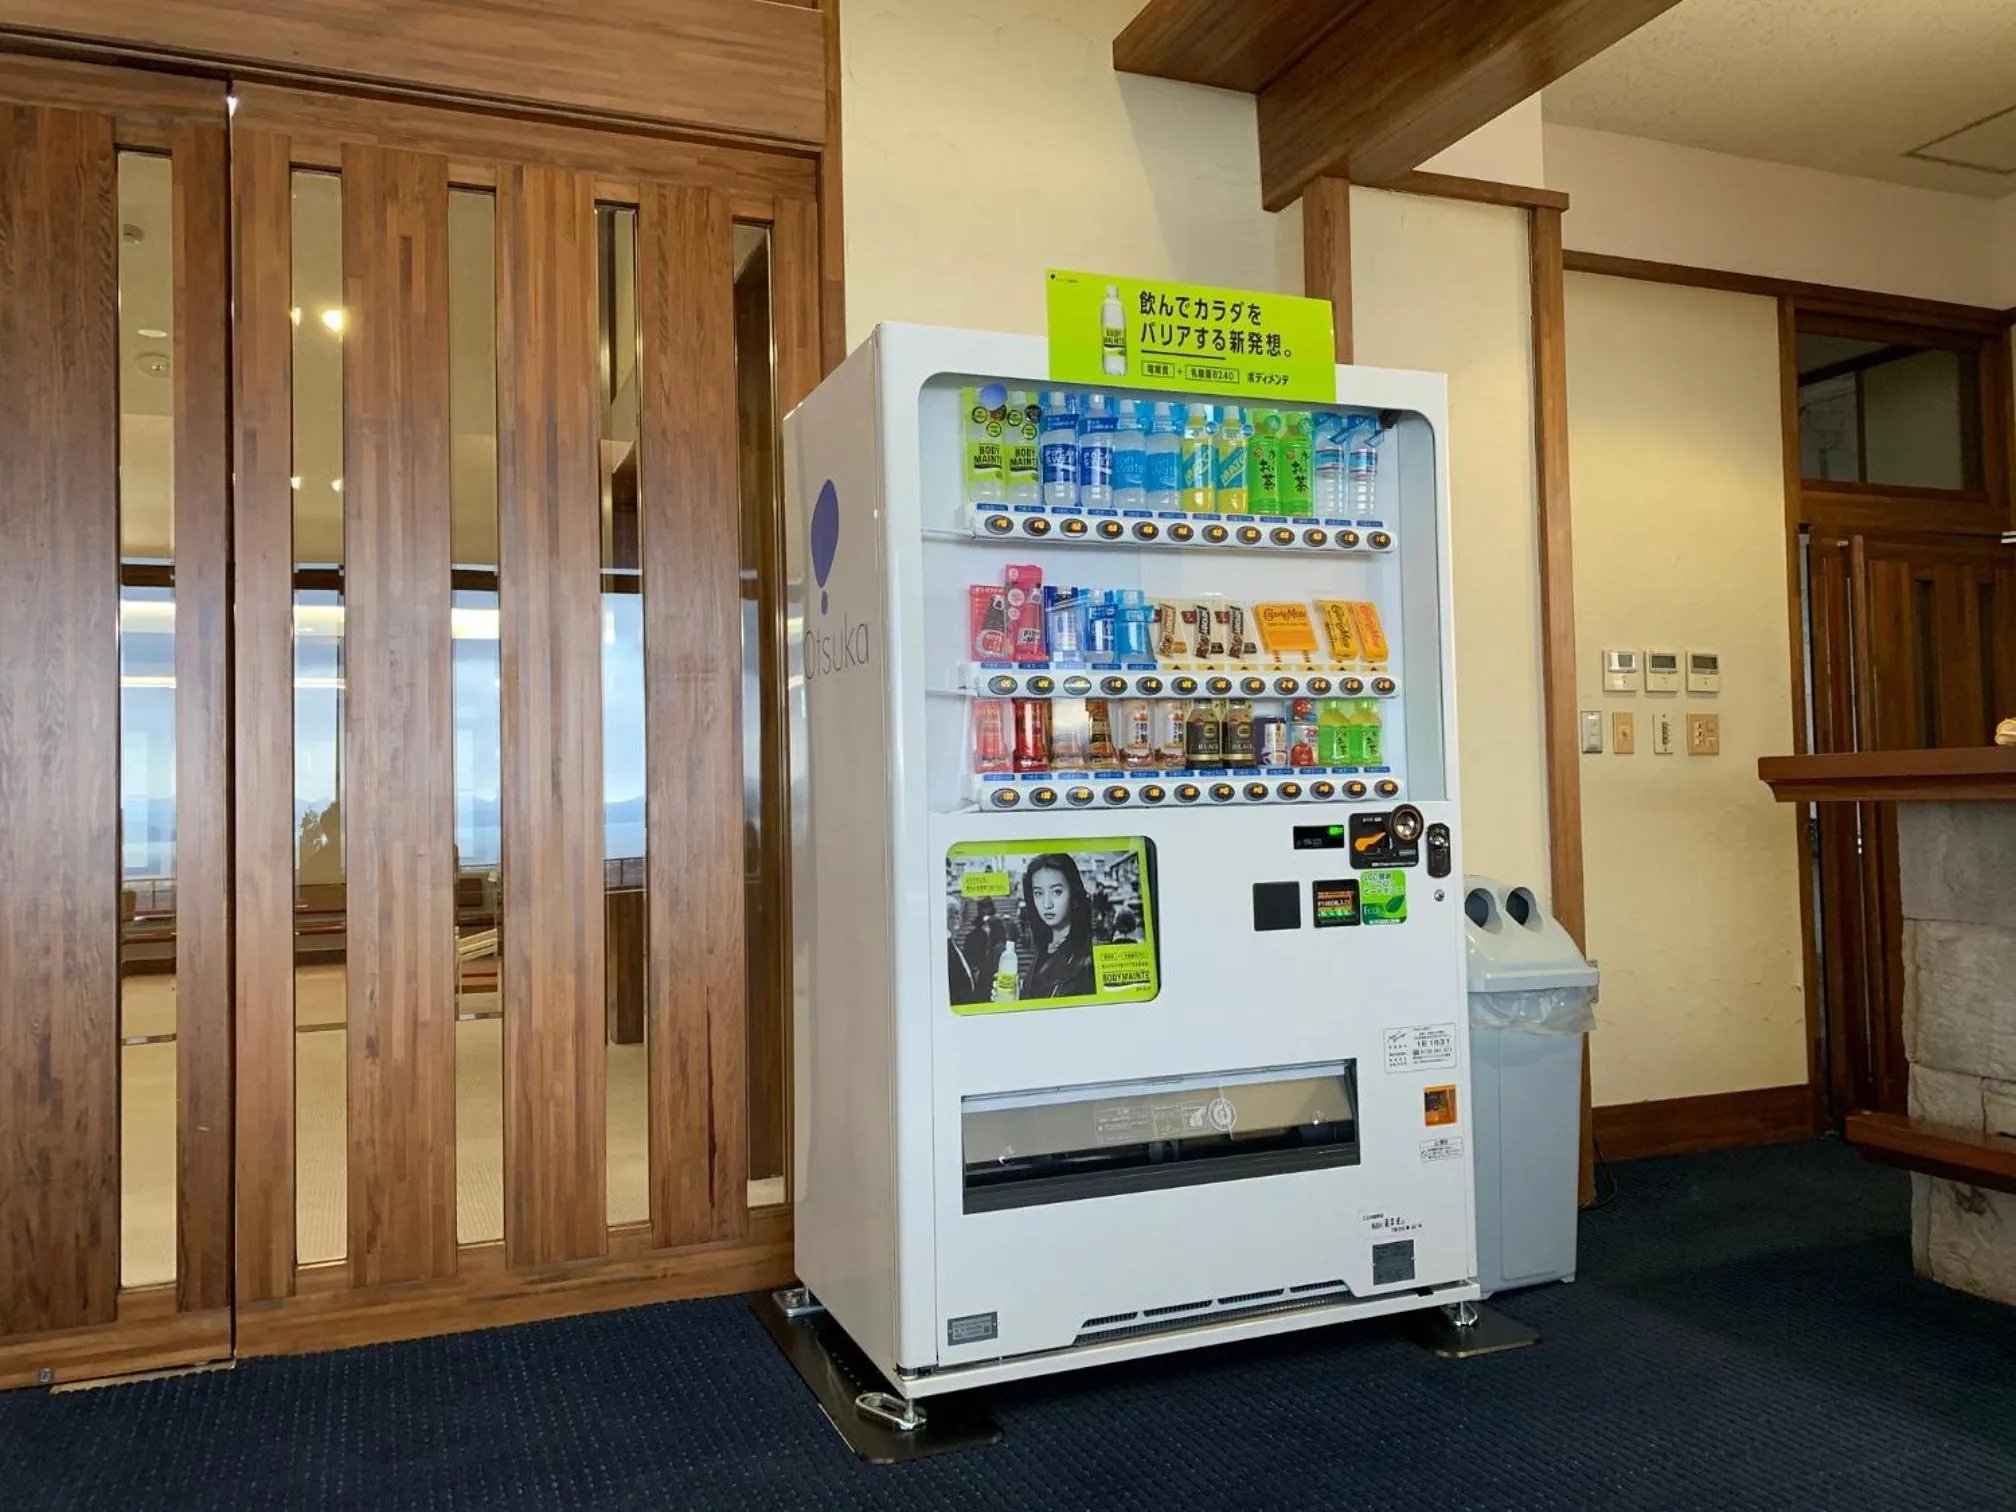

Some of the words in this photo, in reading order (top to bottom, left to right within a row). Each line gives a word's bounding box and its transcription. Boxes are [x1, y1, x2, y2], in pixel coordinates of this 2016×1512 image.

[1139, 290, 1262, 326] 飲んでカラダを
[1140, 321, 1293, 358] バリアする新発想。
[1247, 372, 1290, 386] ボディメンテ
[803, 612, 869, 680] Otsuka
